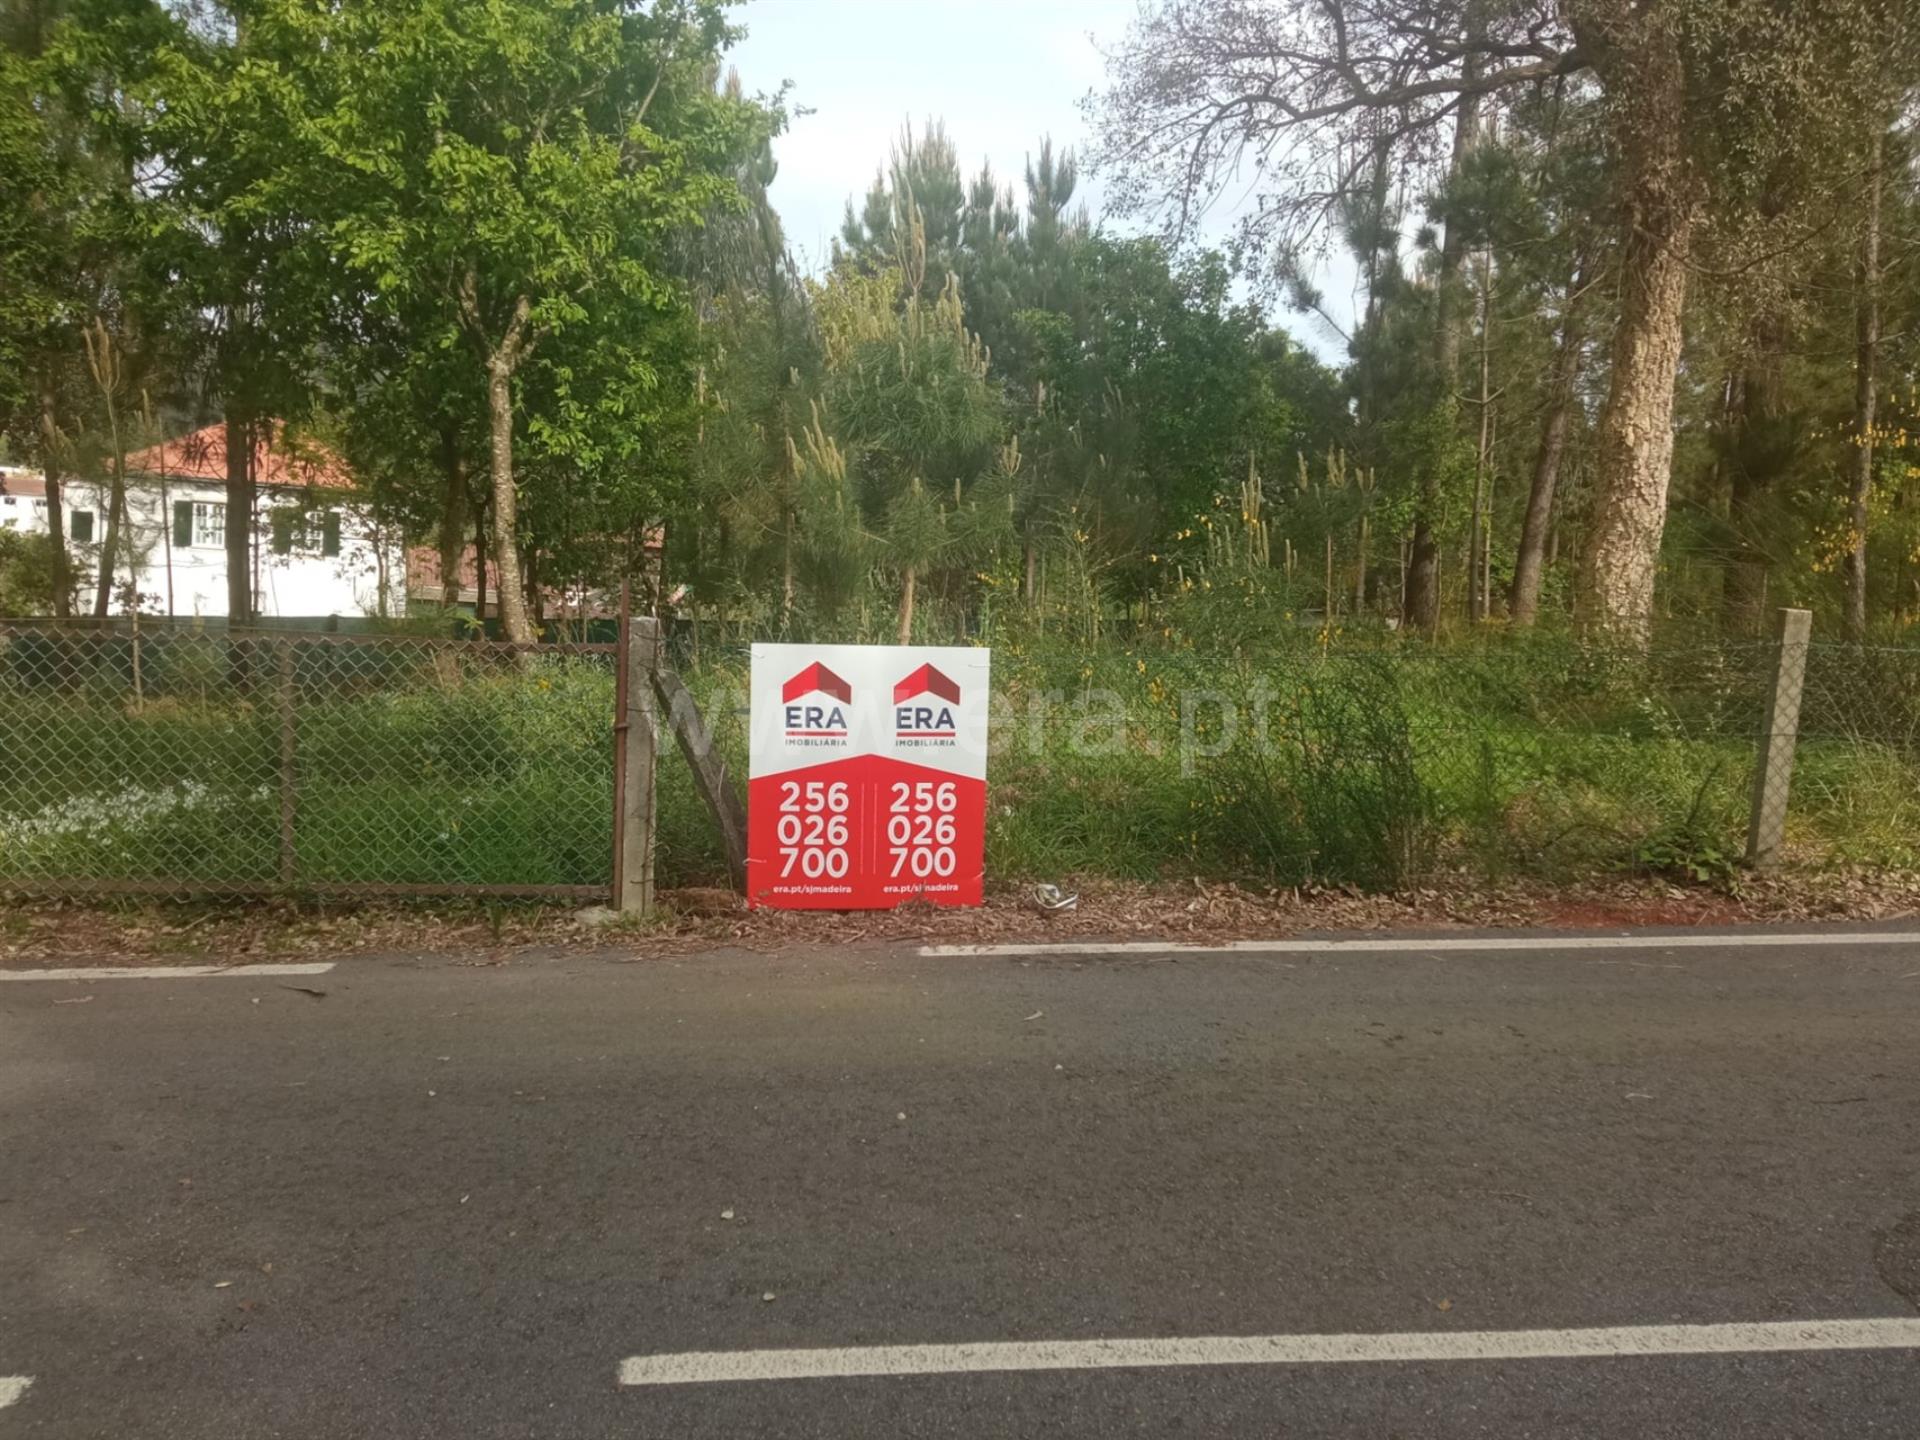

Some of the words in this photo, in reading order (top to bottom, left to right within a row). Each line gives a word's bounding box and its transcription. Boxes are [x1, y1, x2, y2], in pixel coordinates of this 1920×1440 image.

[785, 706, 848, 729] ERA
[896, 707, 956, 730] ERA
[785, 737, 848, 747] IMOBILIÁRIA
[895, 737, 956, 747] IMOBILIÁRIA
[779, 781, 849, 812] 256
[890, 782, 957, 812] 256
[777, 814, 849, 846] 026
[887, 814, 957, 846] 026
[779, 847, 849, 879] 700
[889, 847, 957, 878] 700
[773, 884, 853, 895] era.pt/sjmadeira
